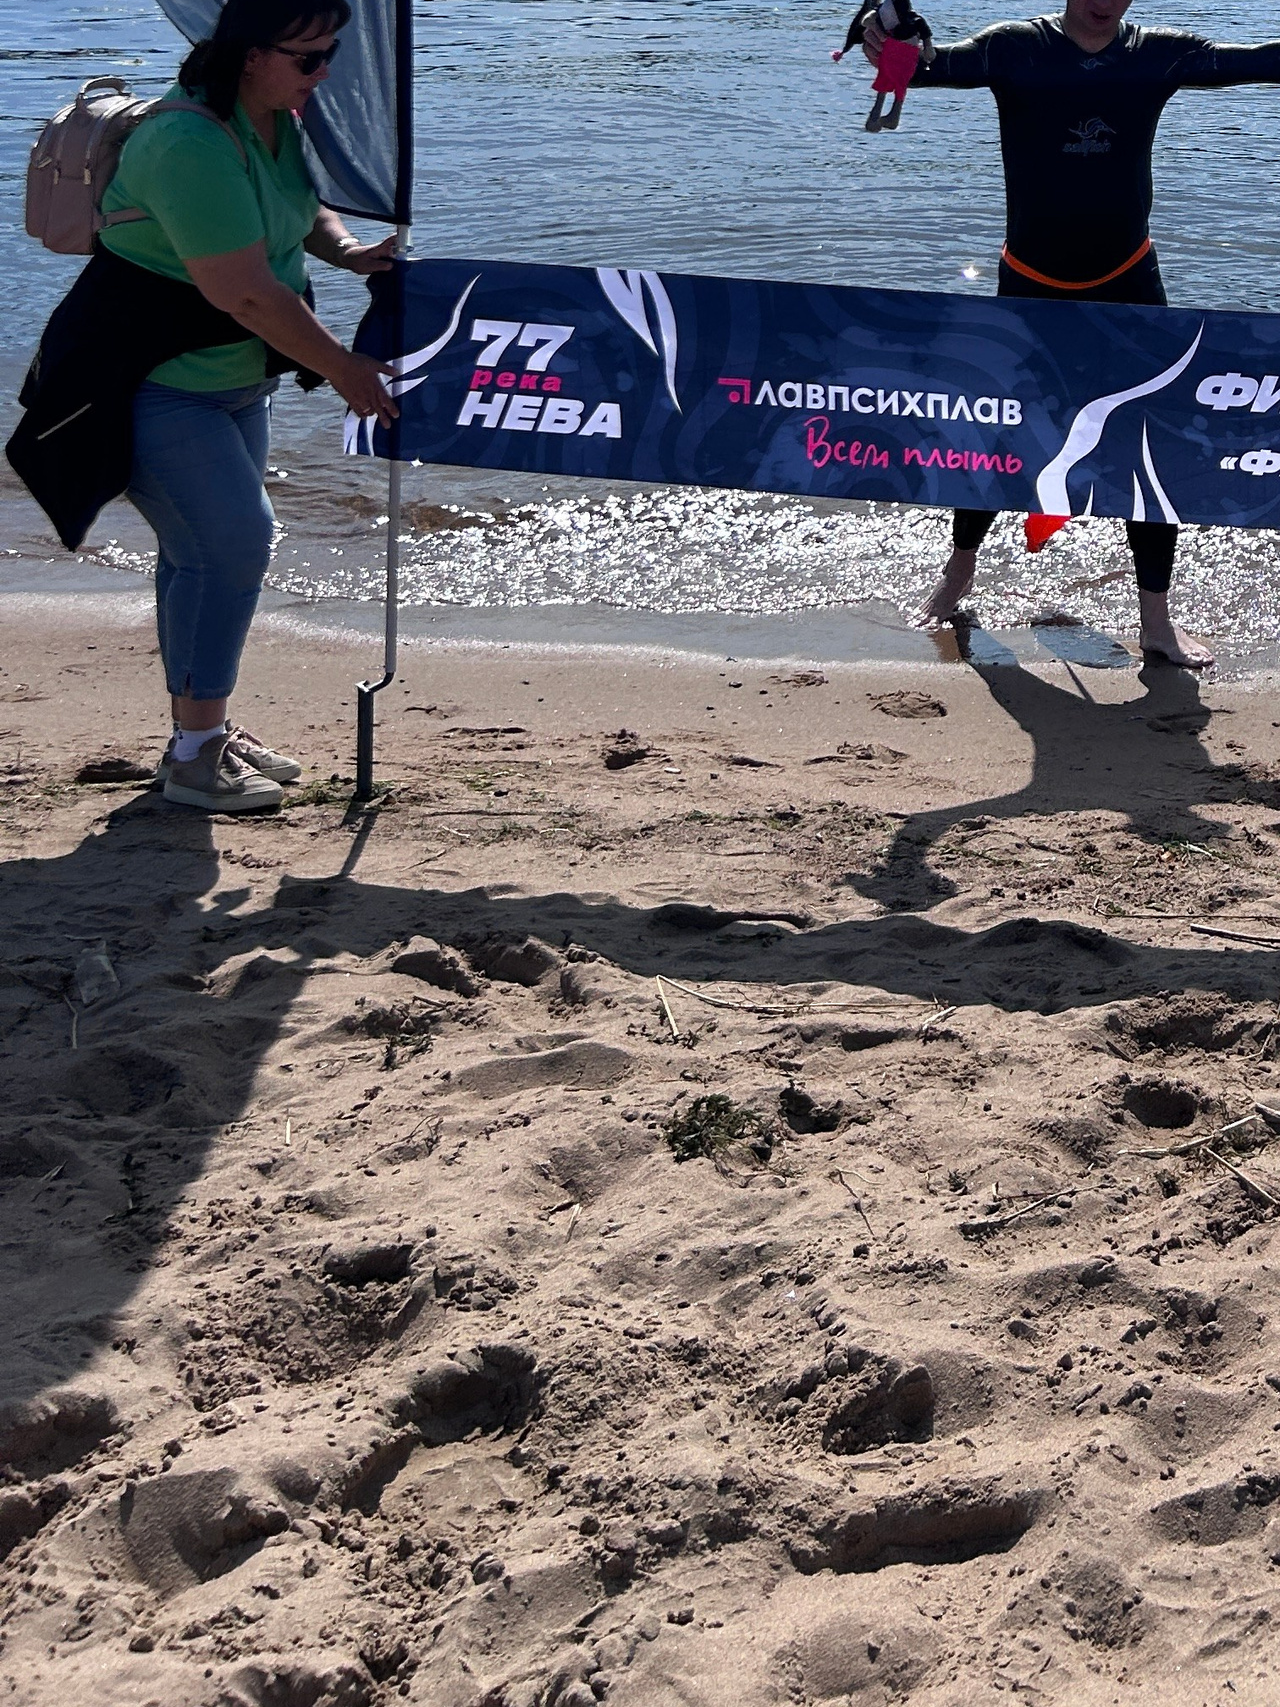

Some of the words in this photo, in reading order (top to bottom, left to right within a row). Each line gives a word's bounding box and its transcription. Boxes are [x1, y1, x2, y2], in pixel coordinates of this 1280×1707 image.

[470, 319, 575, 371] 77
[470, 369, 561, 392] река
[456, 390, 622, 439] НЕВА
[804, 415, 890, 469] Всем
[903, 447, 1023, 475] плыть
